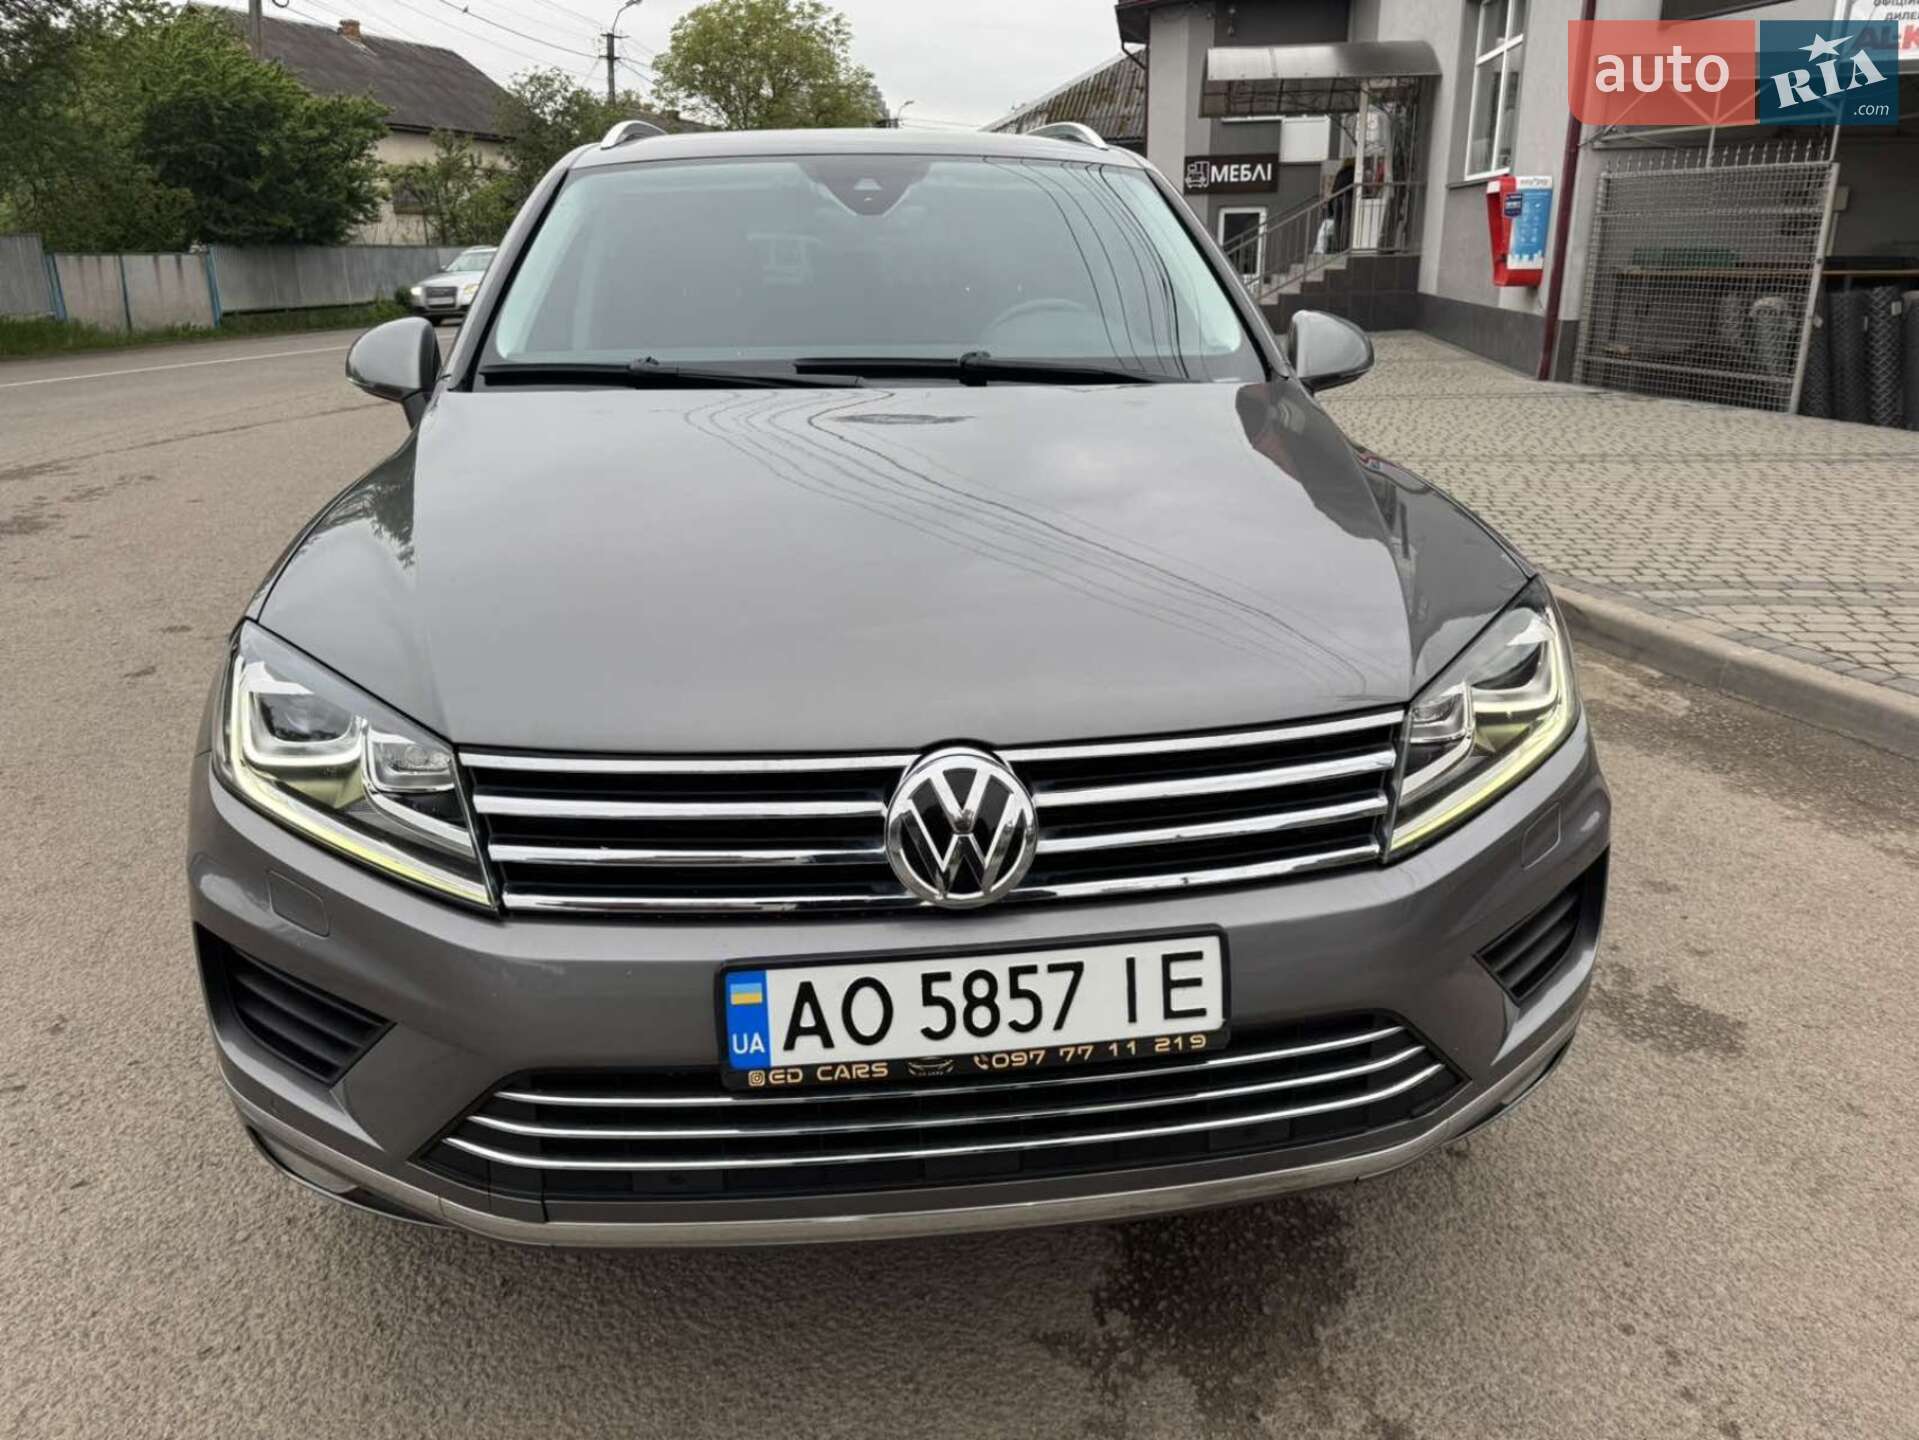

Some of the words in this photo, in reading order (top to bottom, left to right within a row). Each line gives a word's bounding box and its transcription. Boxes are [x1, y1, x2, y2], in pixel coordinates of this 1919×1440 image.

[1885, 11, 1919, 21] ДИЛЕ
[1210, 163, 1272, 183] МЕБЛІ
[782, 976, 894, 1052] AO
[920, 961, 1085, 1041] 5857
[1125, 950, 1207, 1024] IE
[731, 1033, 765, 1055] UA
[768, 1068, 804, 1085] ED
[816, 1062, 889, 1081] CARS
[991, 1049, 1046, 1069] 097
[1058, 1044, 1095, 1062] 77
[1108, 1039, 1137, 1057] 11
[1154, 1033, 1207, 1052] 219
